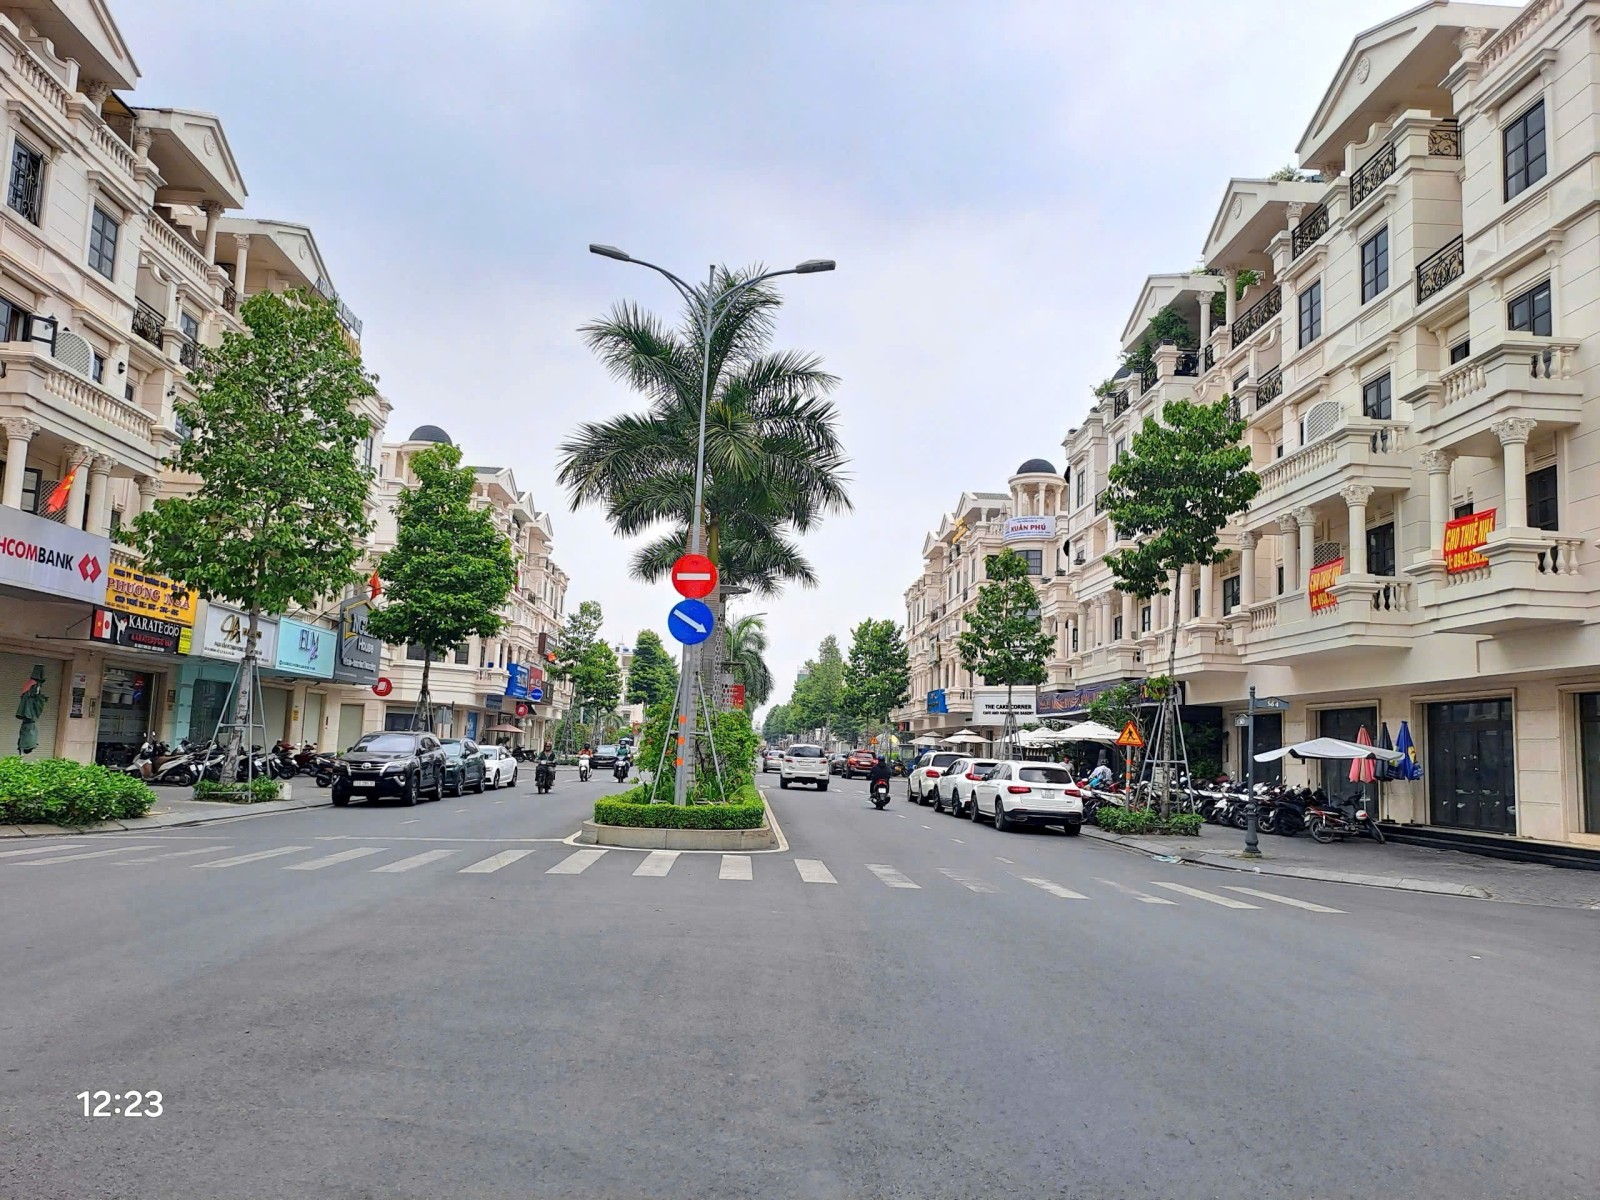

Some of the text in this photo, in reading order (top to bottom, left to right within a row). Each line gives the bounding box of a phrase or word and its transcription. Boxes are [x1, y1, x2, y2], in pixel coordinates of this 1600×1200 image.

[1445, 526, 1461, 552] CHO
[1460, 516, 1479, 549] THUÊ
[107, 577, 161, 602] PHƯƠNG
[128, 614, 164, 635] KARATE
